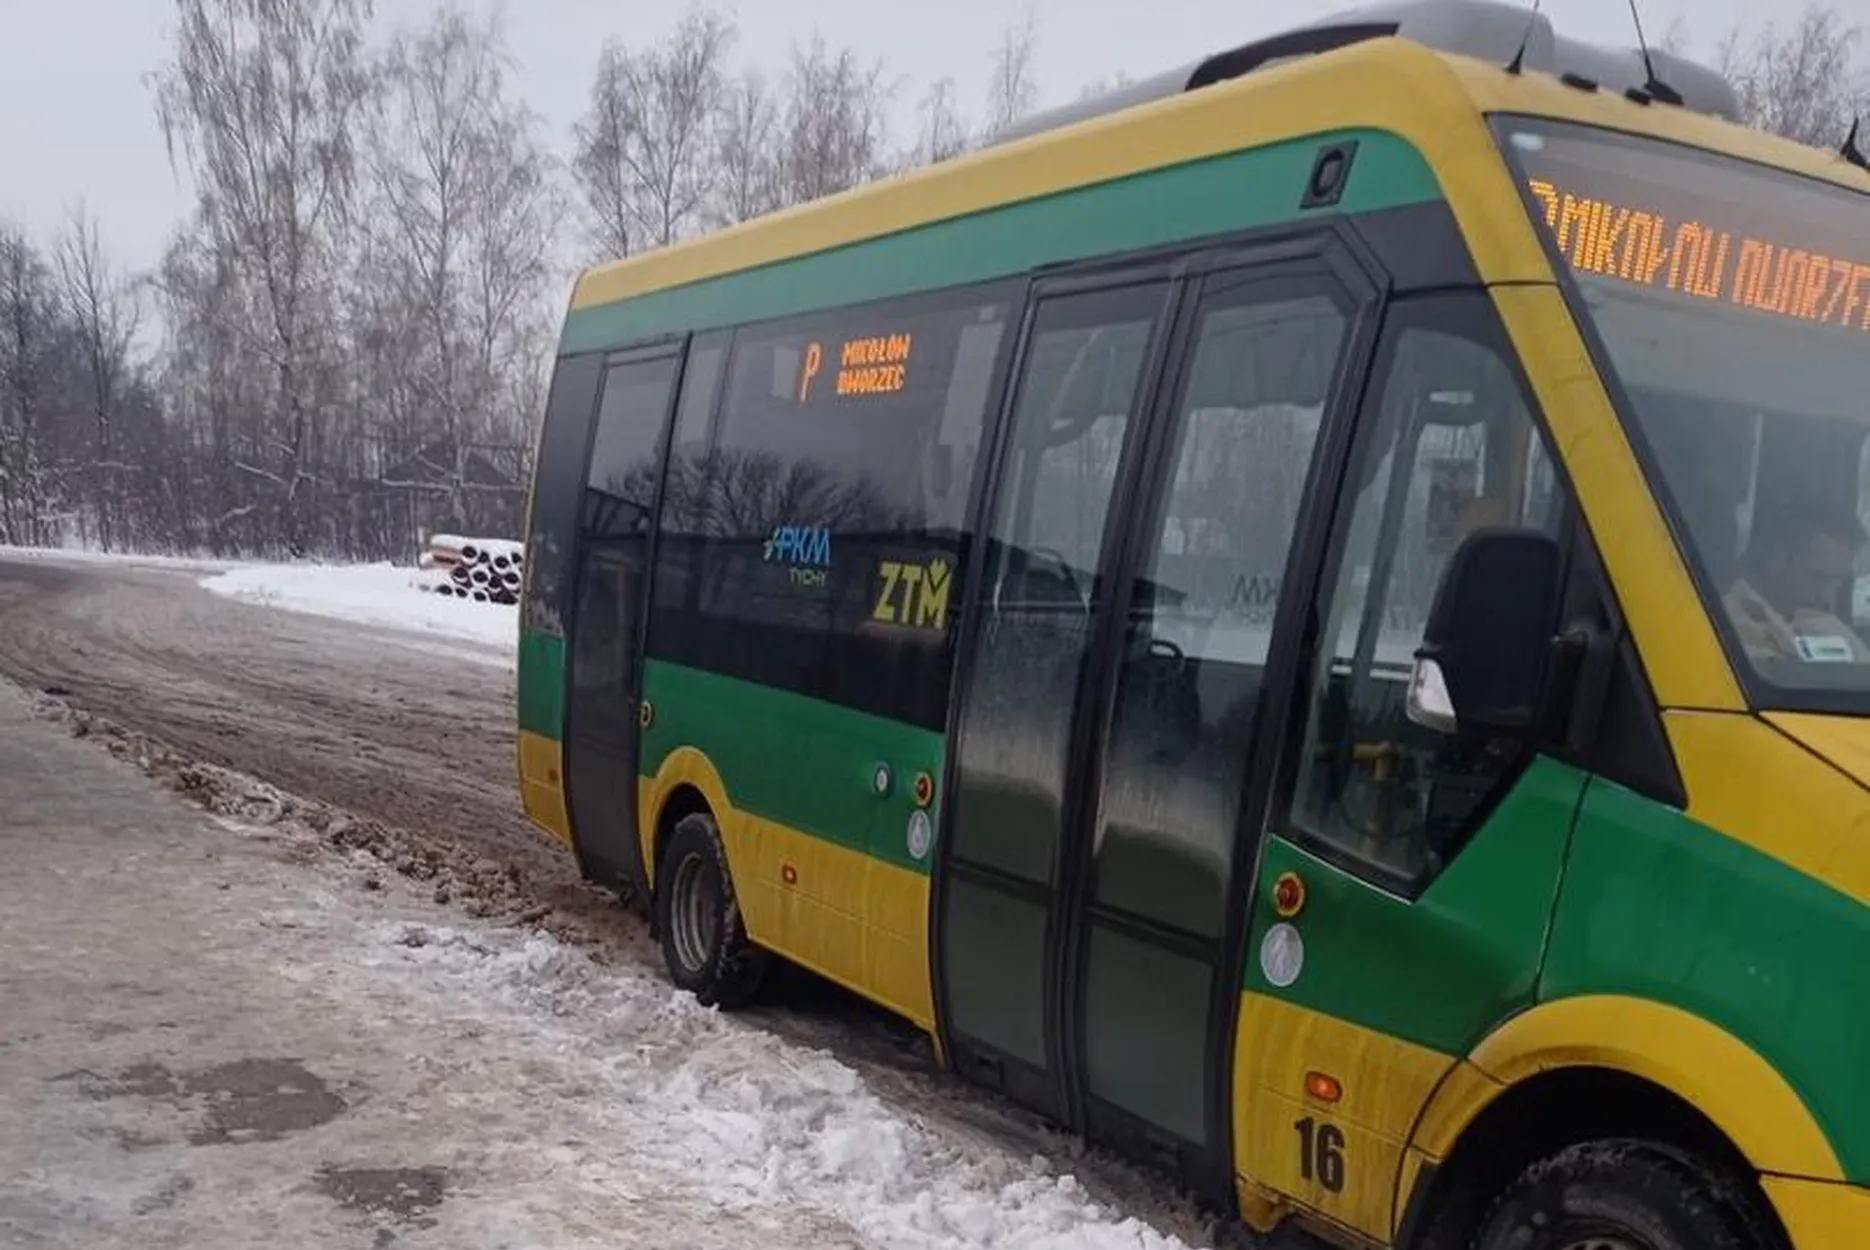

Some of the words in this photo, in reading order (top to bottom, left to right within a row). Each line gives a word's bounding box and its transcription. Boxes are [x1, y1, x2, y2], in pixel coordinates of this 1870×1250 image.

[1732, 239, 1870, 332] DWORZE
[801, 342, 822, 402] P
[837, 364, 906, 395] DWORZEC
[777, 526, 830, 565] PKM
[873, 559, 951, 630] ZTM
[1295, 1116, 1346, 1194] 16
